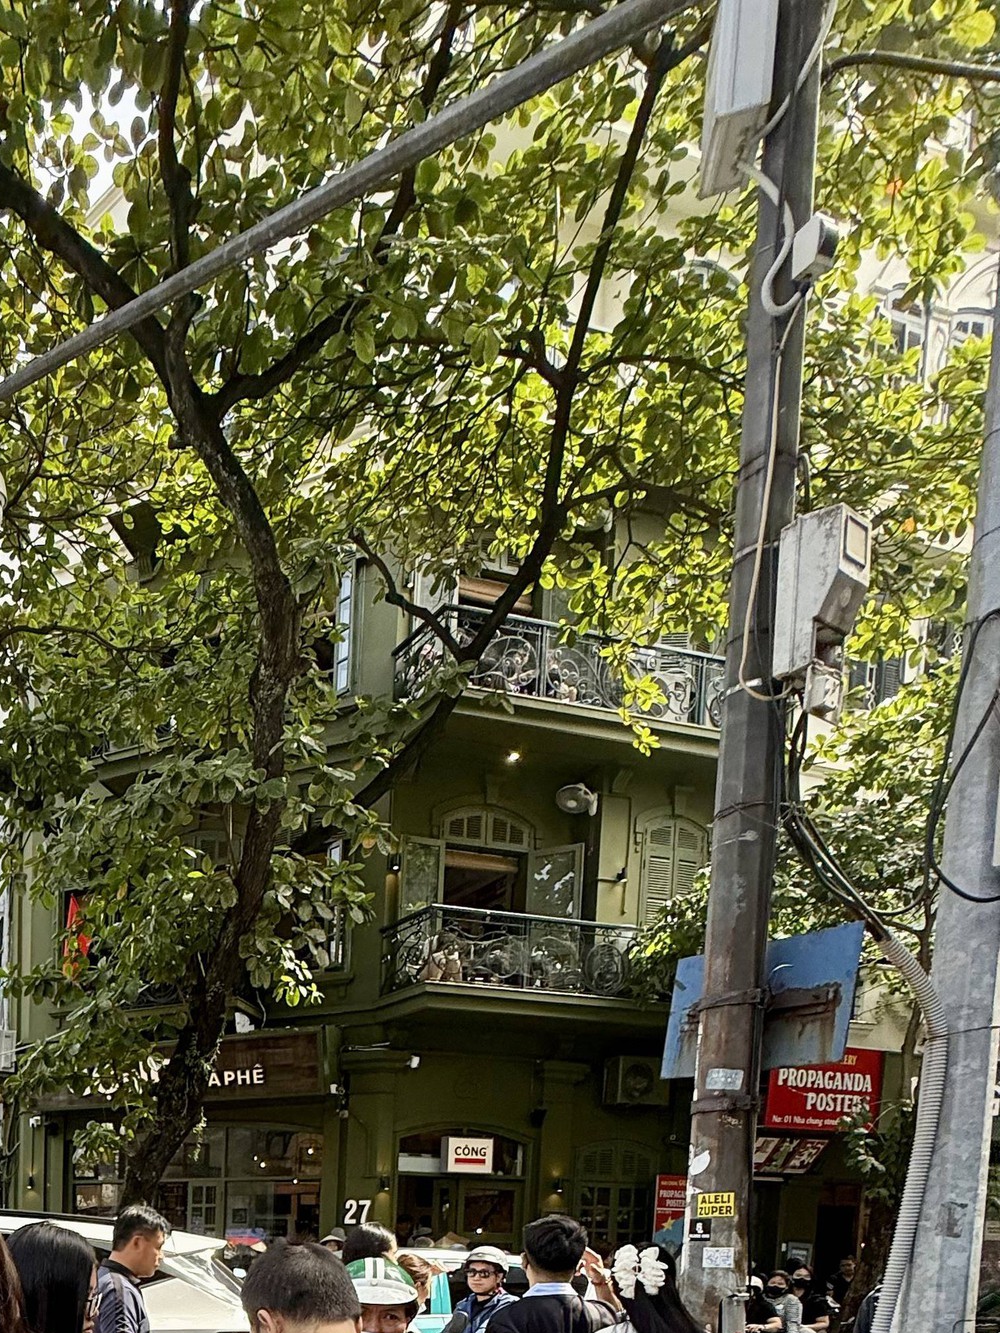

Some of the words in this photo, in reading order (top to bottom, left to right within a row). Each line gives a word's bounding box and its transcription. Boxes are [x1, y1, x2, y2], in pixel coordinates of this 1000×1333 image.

[777, 1068, 872, 1093] PROPAGANDA
[700, 1194, 731, 1205] ALELI
[343, 1199, 372, 1225] 27
[699, 1205, 733, 1216] ZUPER
